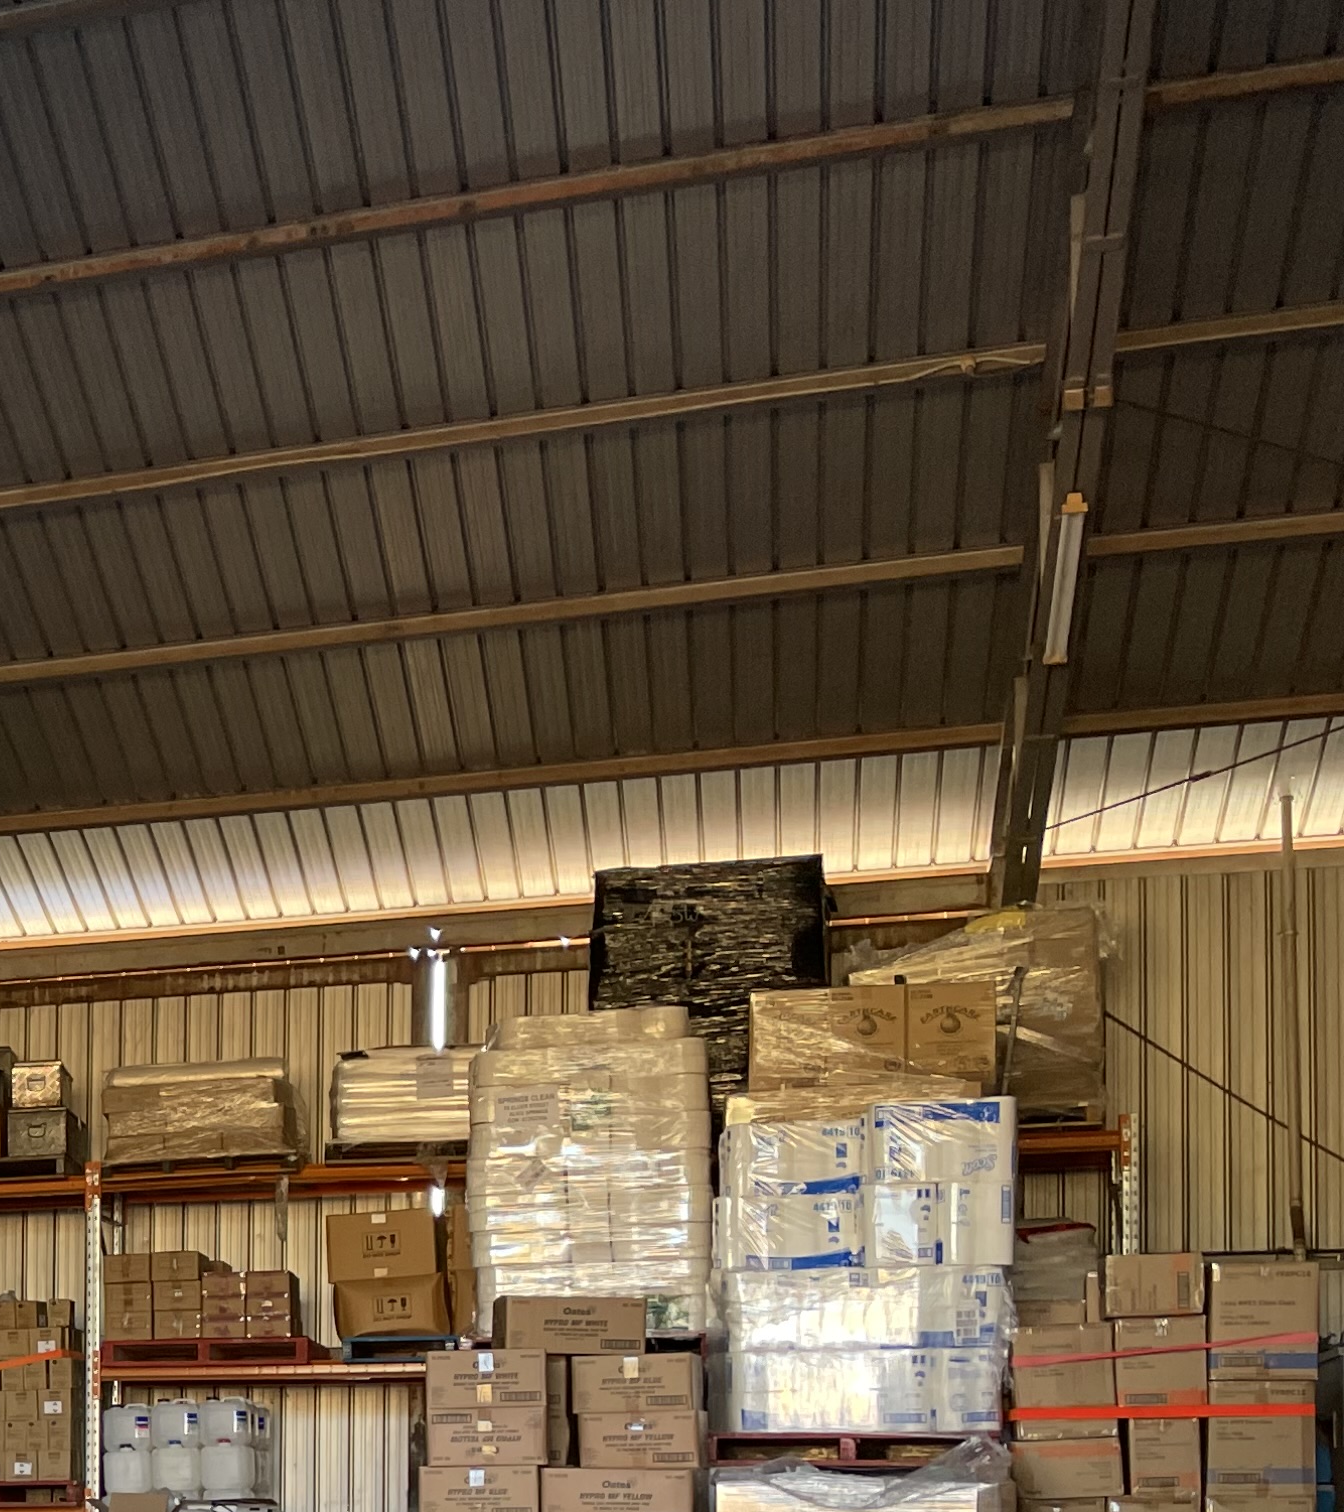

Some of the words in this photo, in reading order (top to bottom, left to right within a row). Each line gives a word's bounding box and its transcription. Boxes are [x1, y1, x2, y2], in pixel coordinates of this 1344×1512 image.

[531, 1093, 555, 1102] CLEAN
[849, 1128, 860, 1137] 10
[962, 1154, 997, 1176] Scott
[841, 1200, 852, 1211] 10
[563, 1306, 591, 1316] Oates
[585, 1319, 608, 1327] WHITE
[602, 1480, 631, 1489] Oates
[623, 1493, 653, 1501] YELLOW
